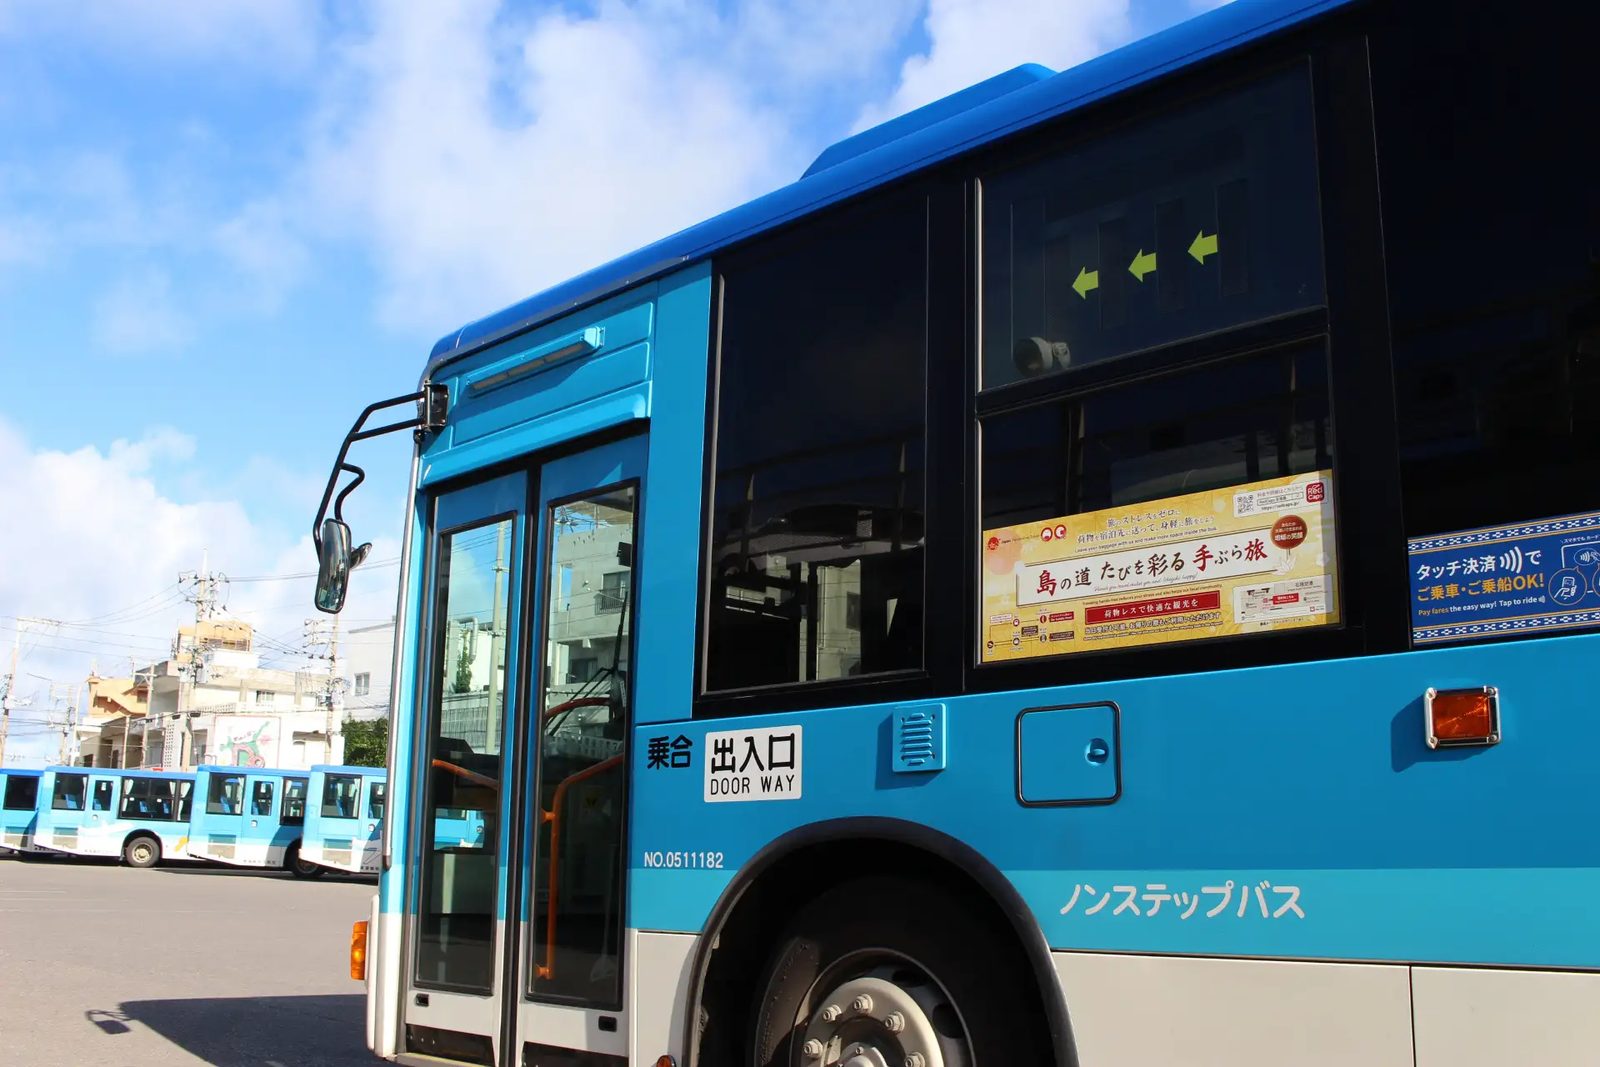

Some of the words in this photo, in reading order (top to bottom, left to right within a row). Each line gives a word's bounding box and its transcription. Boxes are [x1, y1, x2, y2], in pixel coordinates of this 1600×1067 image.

[1037, 567, 1092, 596] 島の道
[1100, 552, 1185, 581] たびを彩る
[1192, 538, 1268, 572] 手ぶら旅
[1416, 555, 1496, 581] タッチ決済
[1525, 550, 1542, 565] で
[1417, 572, 1545, 602] ご乗車・ご乗船OK!
[1104, 599, 1198, 619] 荷物レスで快適な観光を
[1418, 609, 1430, 617] Pay
[1432, 607, 1449, 615] fares
[1463, 605, 1478, 613] easy
[1480, 602, 1497, 611] way!
[1499, 600, 1512, 608] Tap
[1523, 596, 1537, 604] ride
[647, 733, 693, 771] 乗合
[711, 732, 796, 775] 出入口
[710, 776, 750, 795] DOOR
[760, 774, 795, 793] WAY
[643, 851, 724, 869] NO.0511182
[1060, 879, 1305, 920] ノンステップバス
